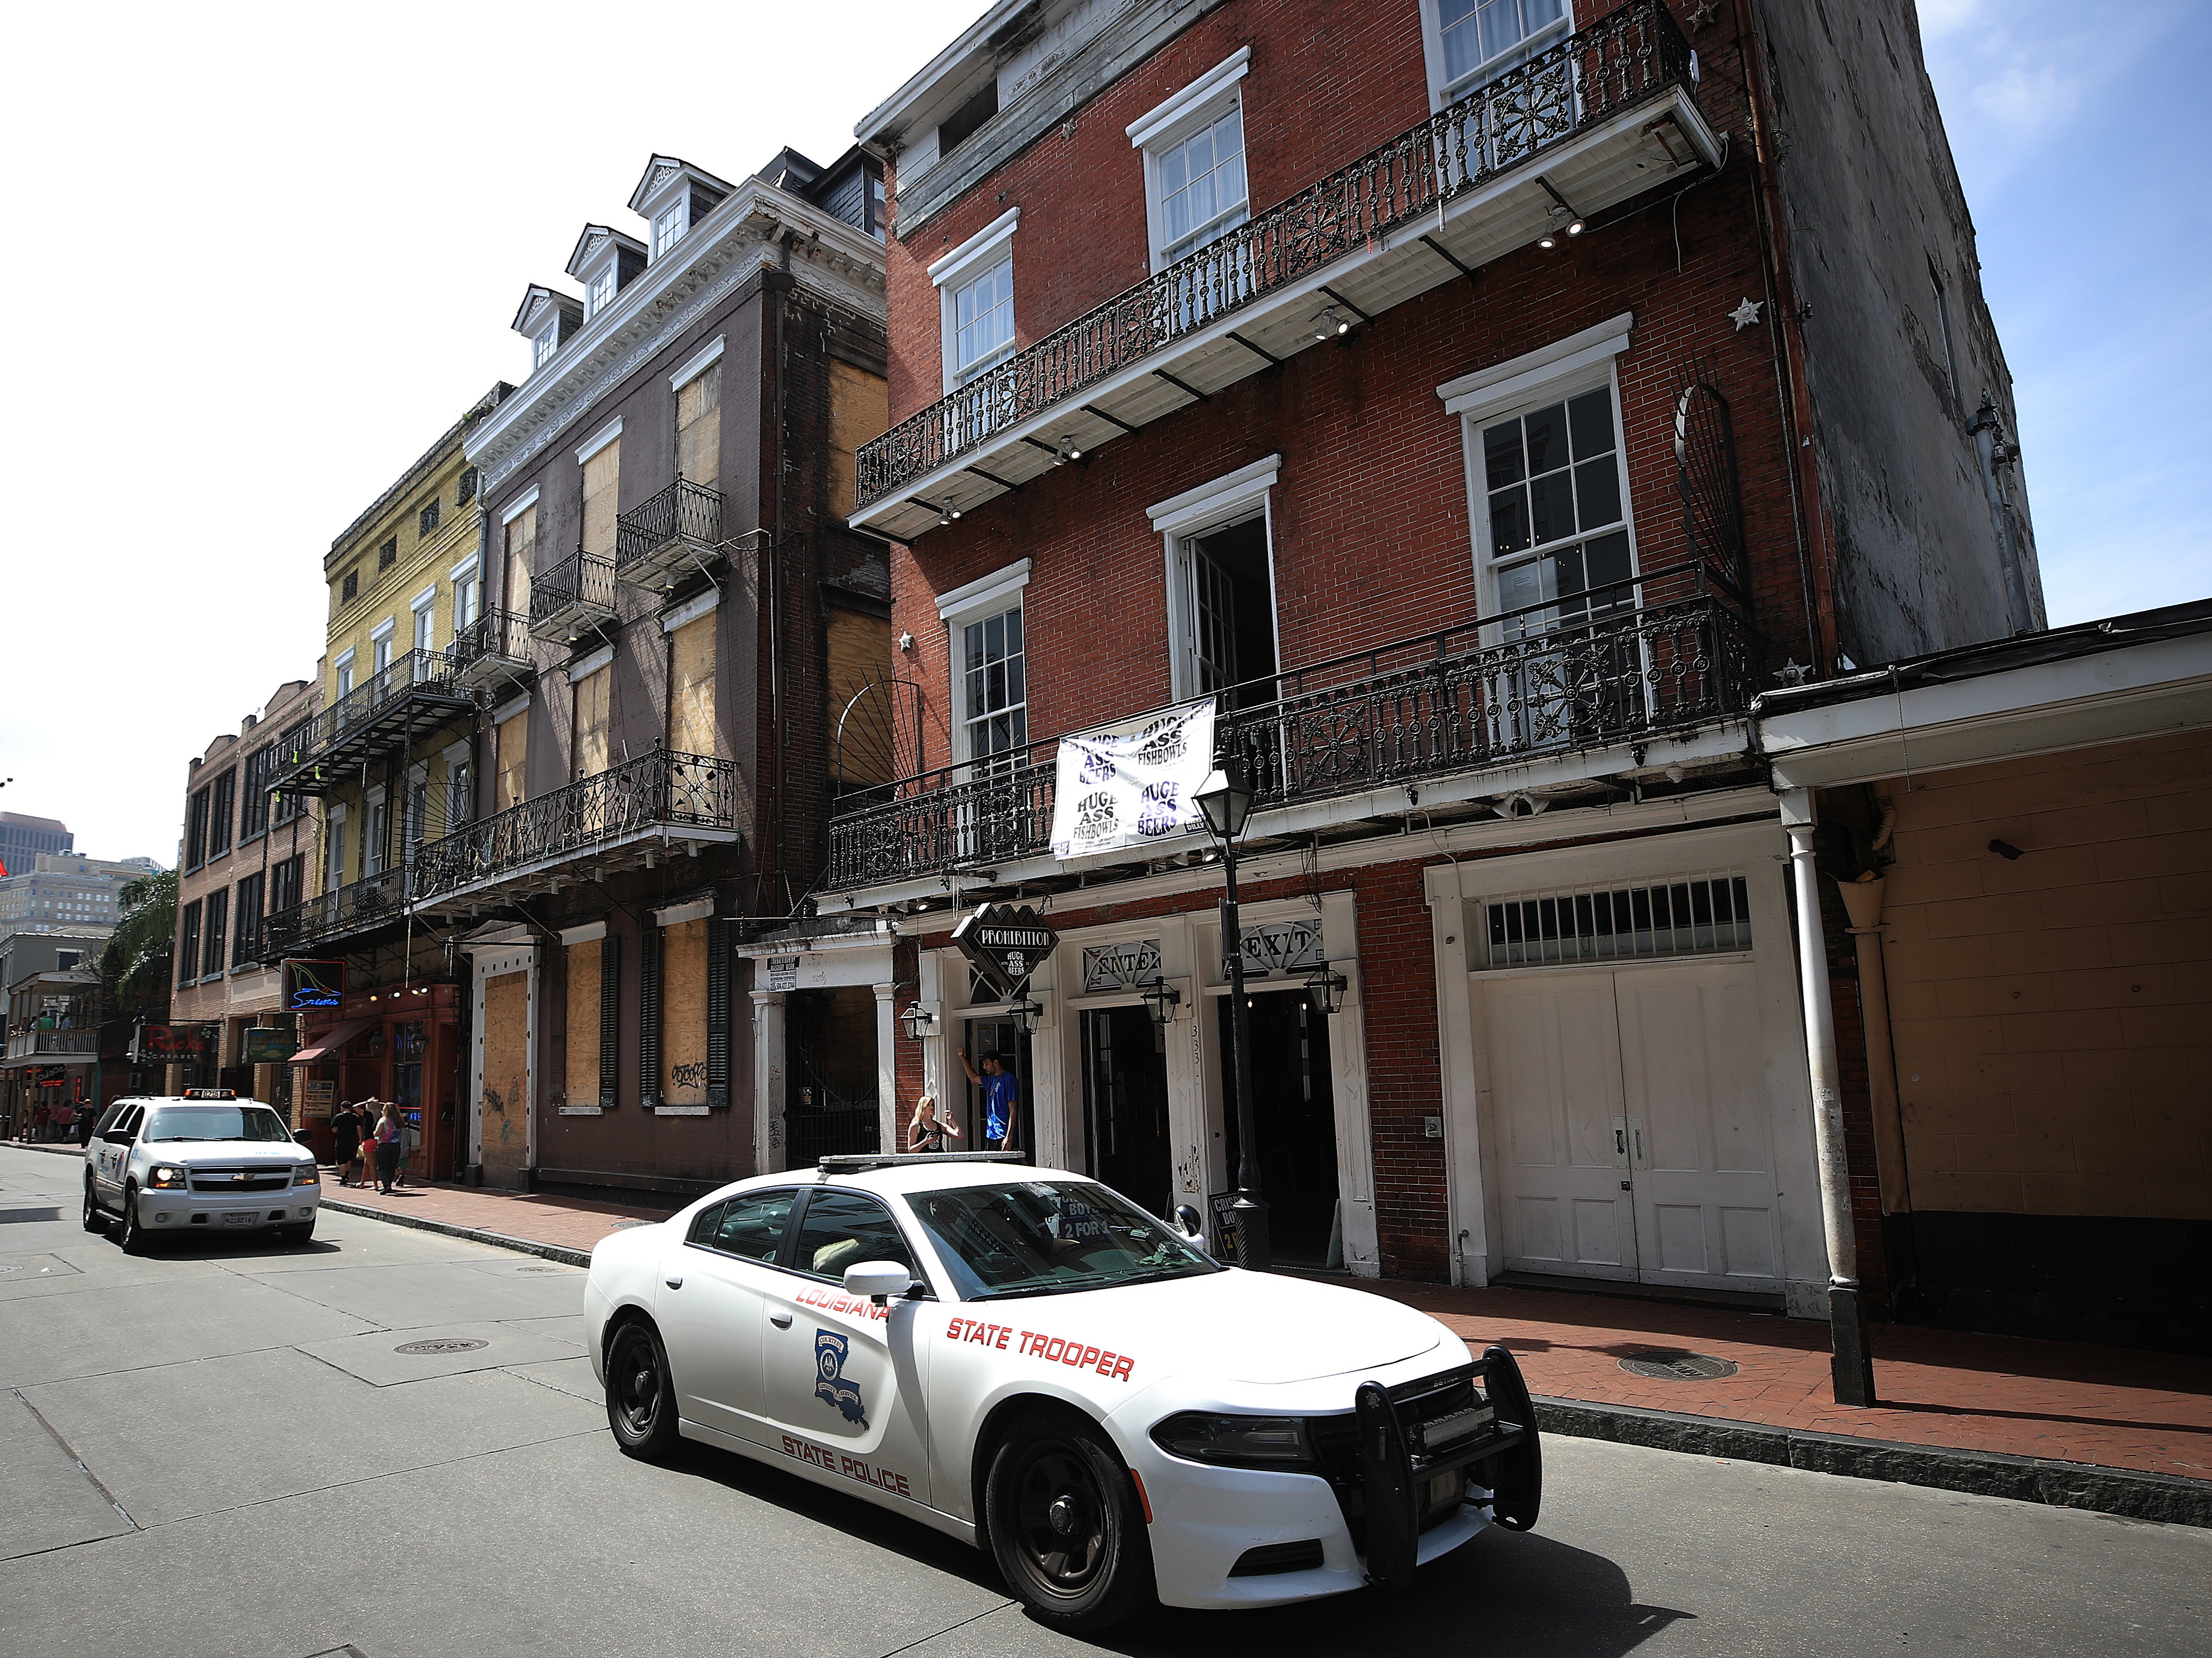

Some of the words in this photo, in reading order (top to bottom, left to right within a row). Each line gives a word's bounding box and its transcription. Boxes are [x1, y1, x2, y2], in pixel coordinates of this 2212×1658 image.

[1142, 730, 1182, 752] ASS
[1137, 742, 1188, 765] FISHBOWLS
[1077, 791, 1119, 813] HUGE
[1141, 781, 1180, 804] HUGE
[1079, 805, 1114, 826] ASS
[1139, 798, 1177, 820] ASS
[1073, 818, 1119, 839] FISHBOWLS
[1137, 814, 1178, 837] BEERS
[1187, 822, 1204, 831] DILLY
[981, 930, 1049, 946] PROHIBITION
[1245, 930, 1311, 959] EXIT
[1007, 951, 1024, 961] HUGE
[1008, 967, 1025, 976] BEERS
[1065, 1223, 1074, 1239] 2
[1075, 1221, 1100, 1238] FOR
[1224, 1233, 1233, 1249] 2
[796, 1287, 890, 1321] LOUISIANA
[819, 1336, 843, 1349] COURTESY
[947, 1317, 1013, 1350] STATE
[1019, 1331, 1135, 1382] TROOPER
[1433, 1374, 1458, 1387] SETINA
[781, 1435, 836, 1470] STATE
[840, 1455, 911, 1497] POLICE
